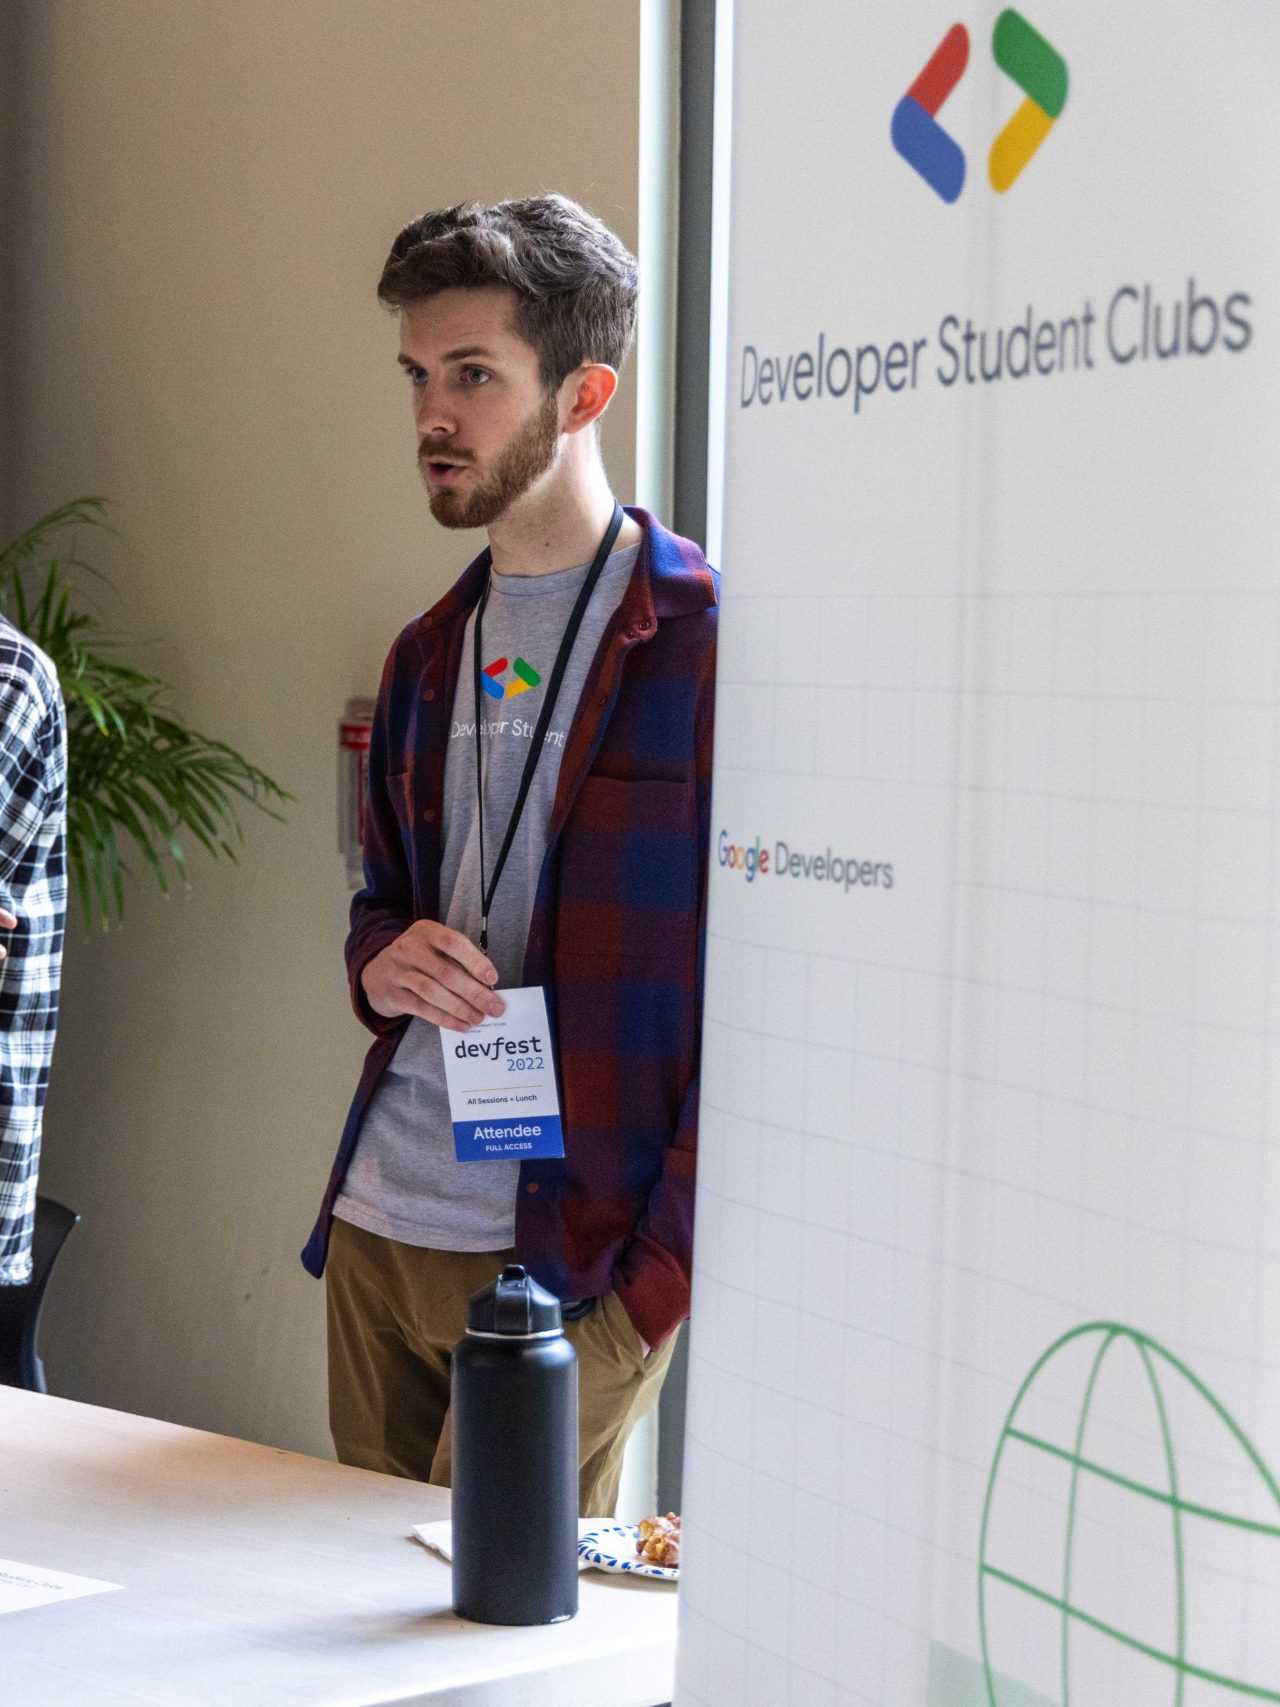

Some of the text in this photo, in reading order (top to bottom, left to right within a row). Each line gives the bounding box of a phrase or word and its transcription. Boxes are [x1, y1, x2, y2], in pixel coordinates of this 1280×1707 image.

[740, 276, 1254, 413] Developer Student Clubs
[719, 829, 894, 894] Google Developers
[455, 1036, 543, 1061] devfest
[507, 1057, 545, 1072] 2022
[467, 1097, 477, 1105] All
[478, 1097, 508, 1105] Sessions
[515, 1094, 538, 1103] Lunch
[473, 1124, 542, 1140] Attendee
[486, 1142, 533, 1152] FULL ACCESS
